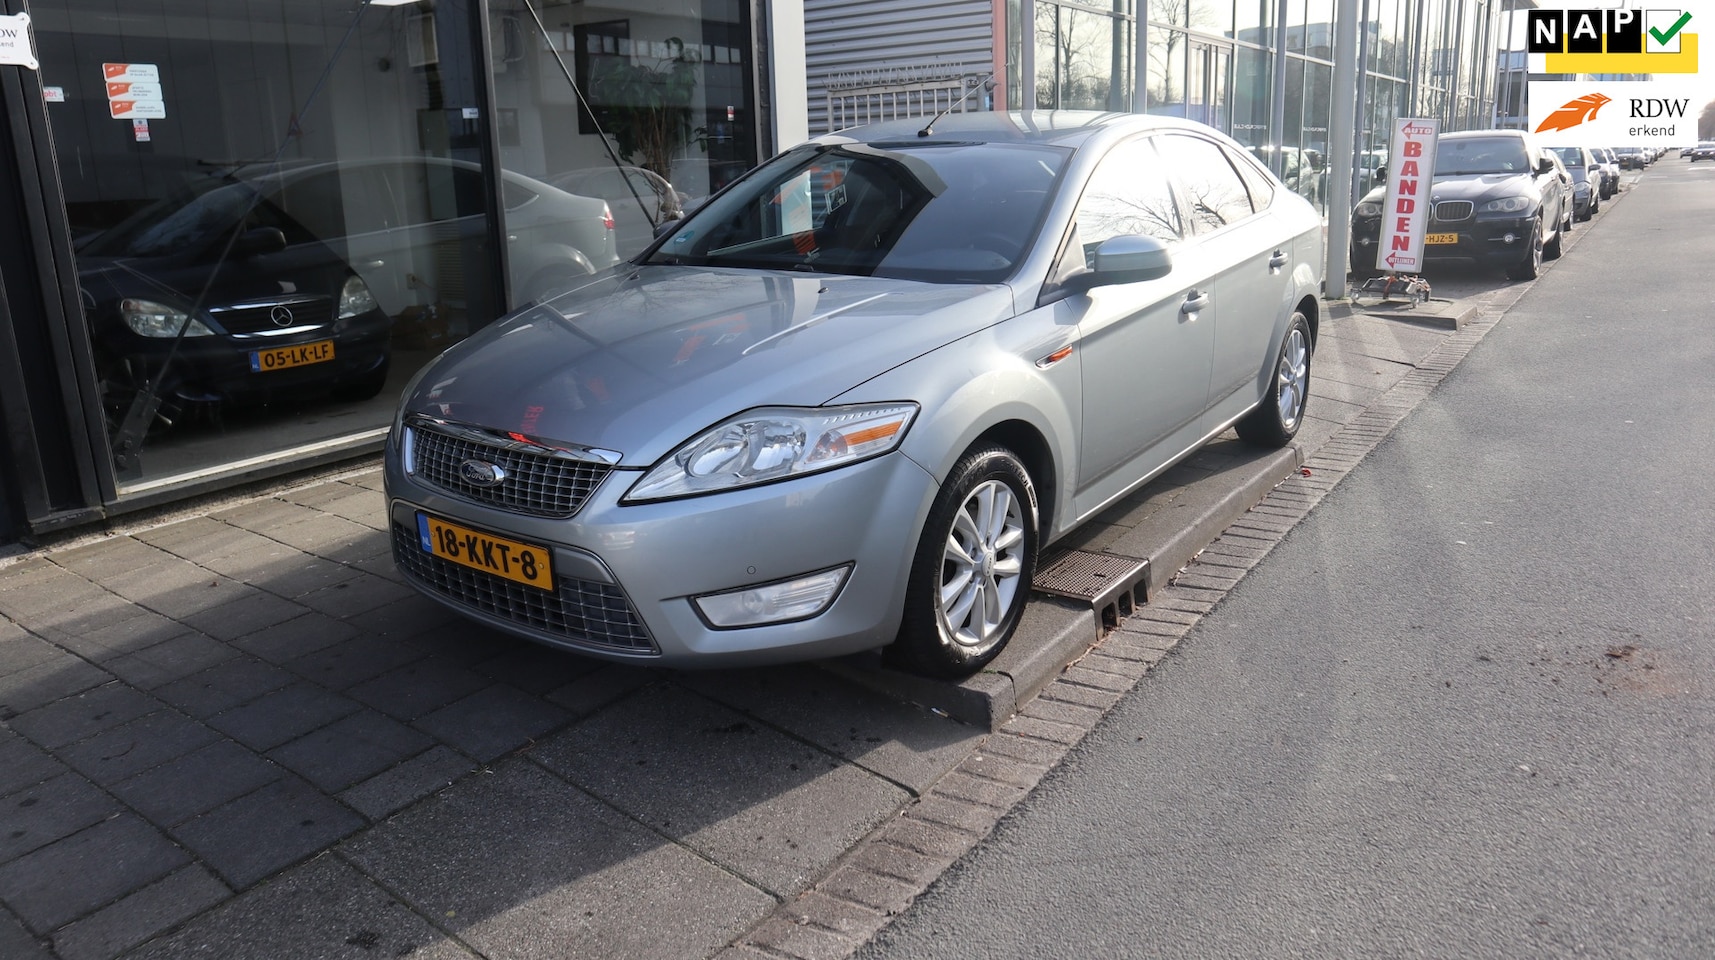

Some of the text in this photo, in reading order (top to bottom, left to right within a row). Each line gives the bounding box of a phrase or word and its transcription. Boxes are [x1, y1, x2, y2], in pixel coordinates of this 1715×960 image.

[1403, 126, 1432, 135] AUTO
[1391, 141, 1422, 251] BANDEN
[264, 344, 329, 368] 05-LK-LF
[421, 535, 431, 547] NL
[435, 525, 538, 581] 18-KKT-8
